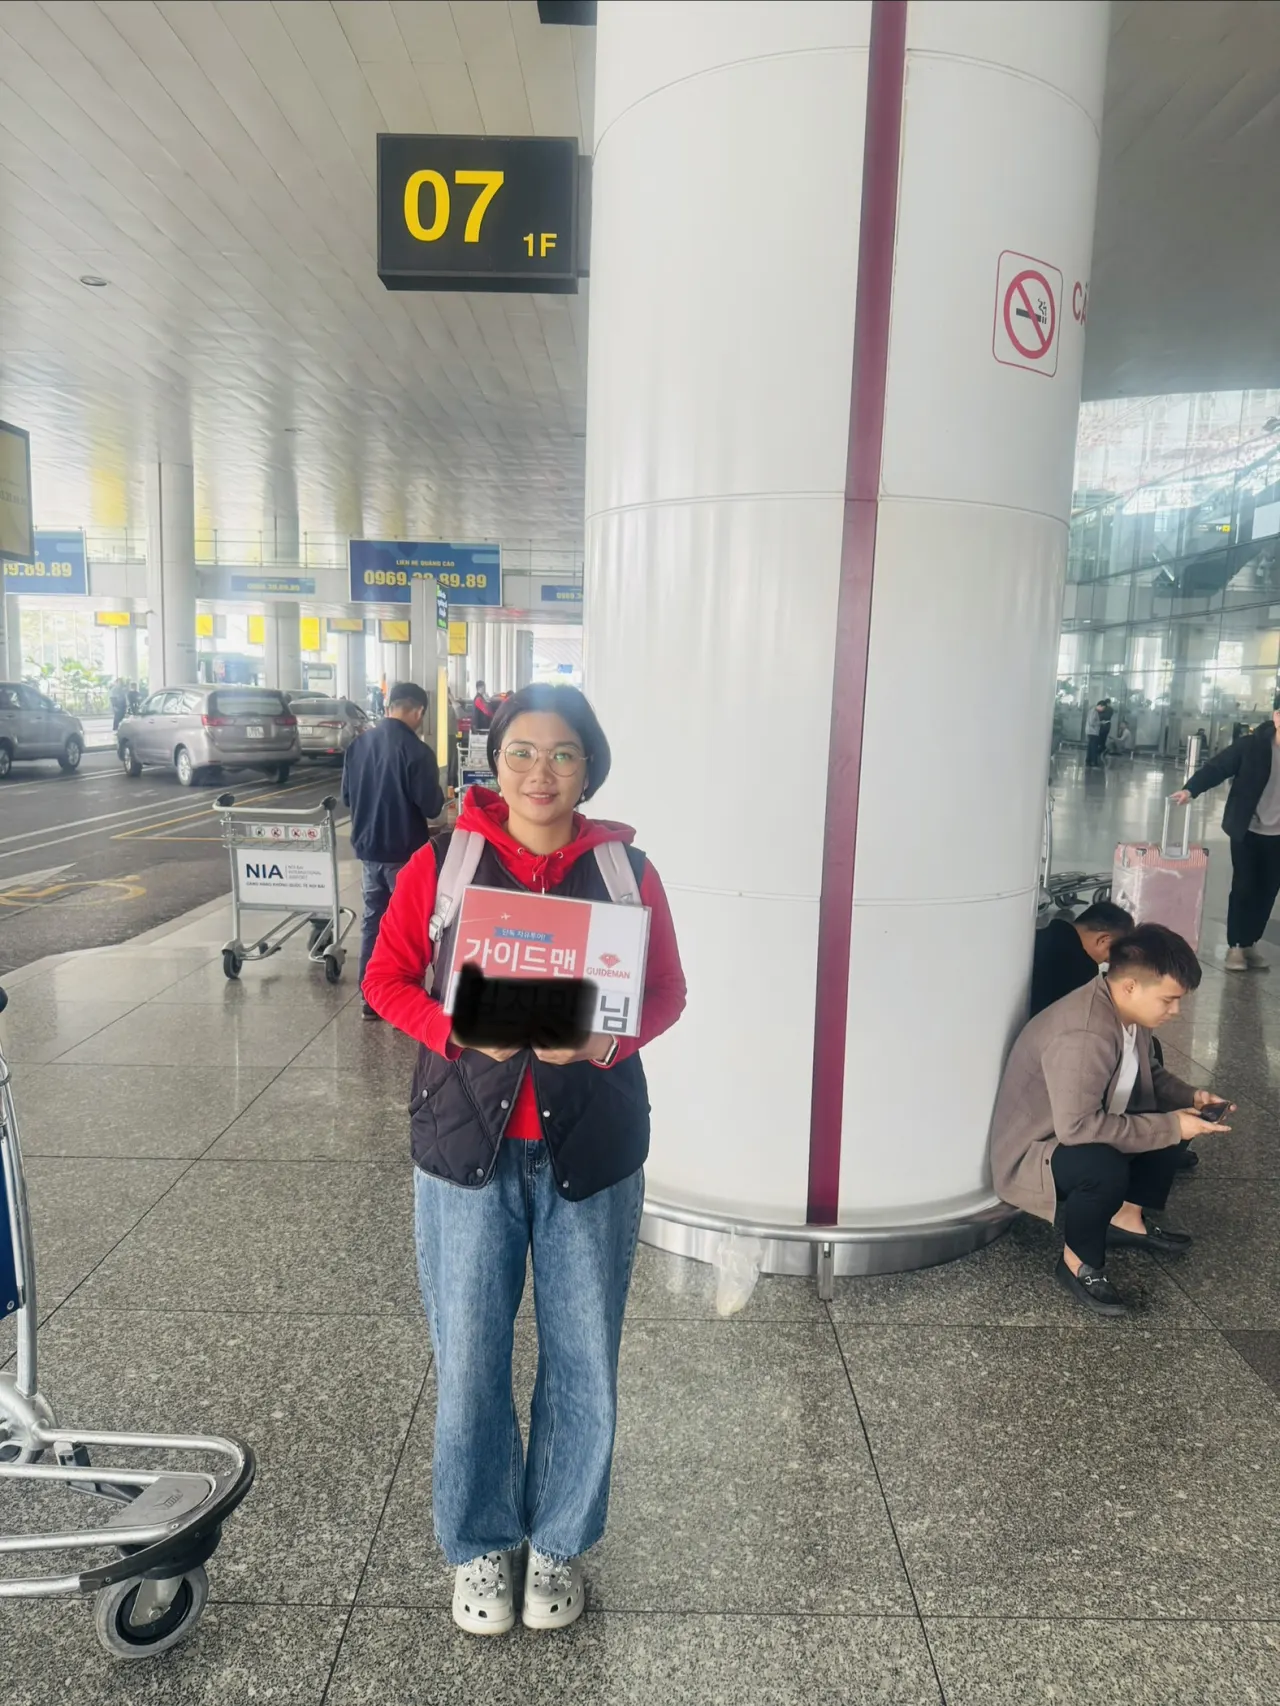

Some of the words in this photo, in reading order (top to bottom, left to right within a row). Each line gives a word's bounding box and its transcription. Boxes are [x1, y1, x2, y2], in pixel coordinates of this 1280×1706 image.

[404, 169, 505, 243] 07
[523, 232, 558, 257] 1F
[245, 863, 284, 880] NIA
[463, 937, 577, 978] 가이드맨
[586, 966, 631, 980] GUIDEMAN
[600, 995, 630, 1033] 님
